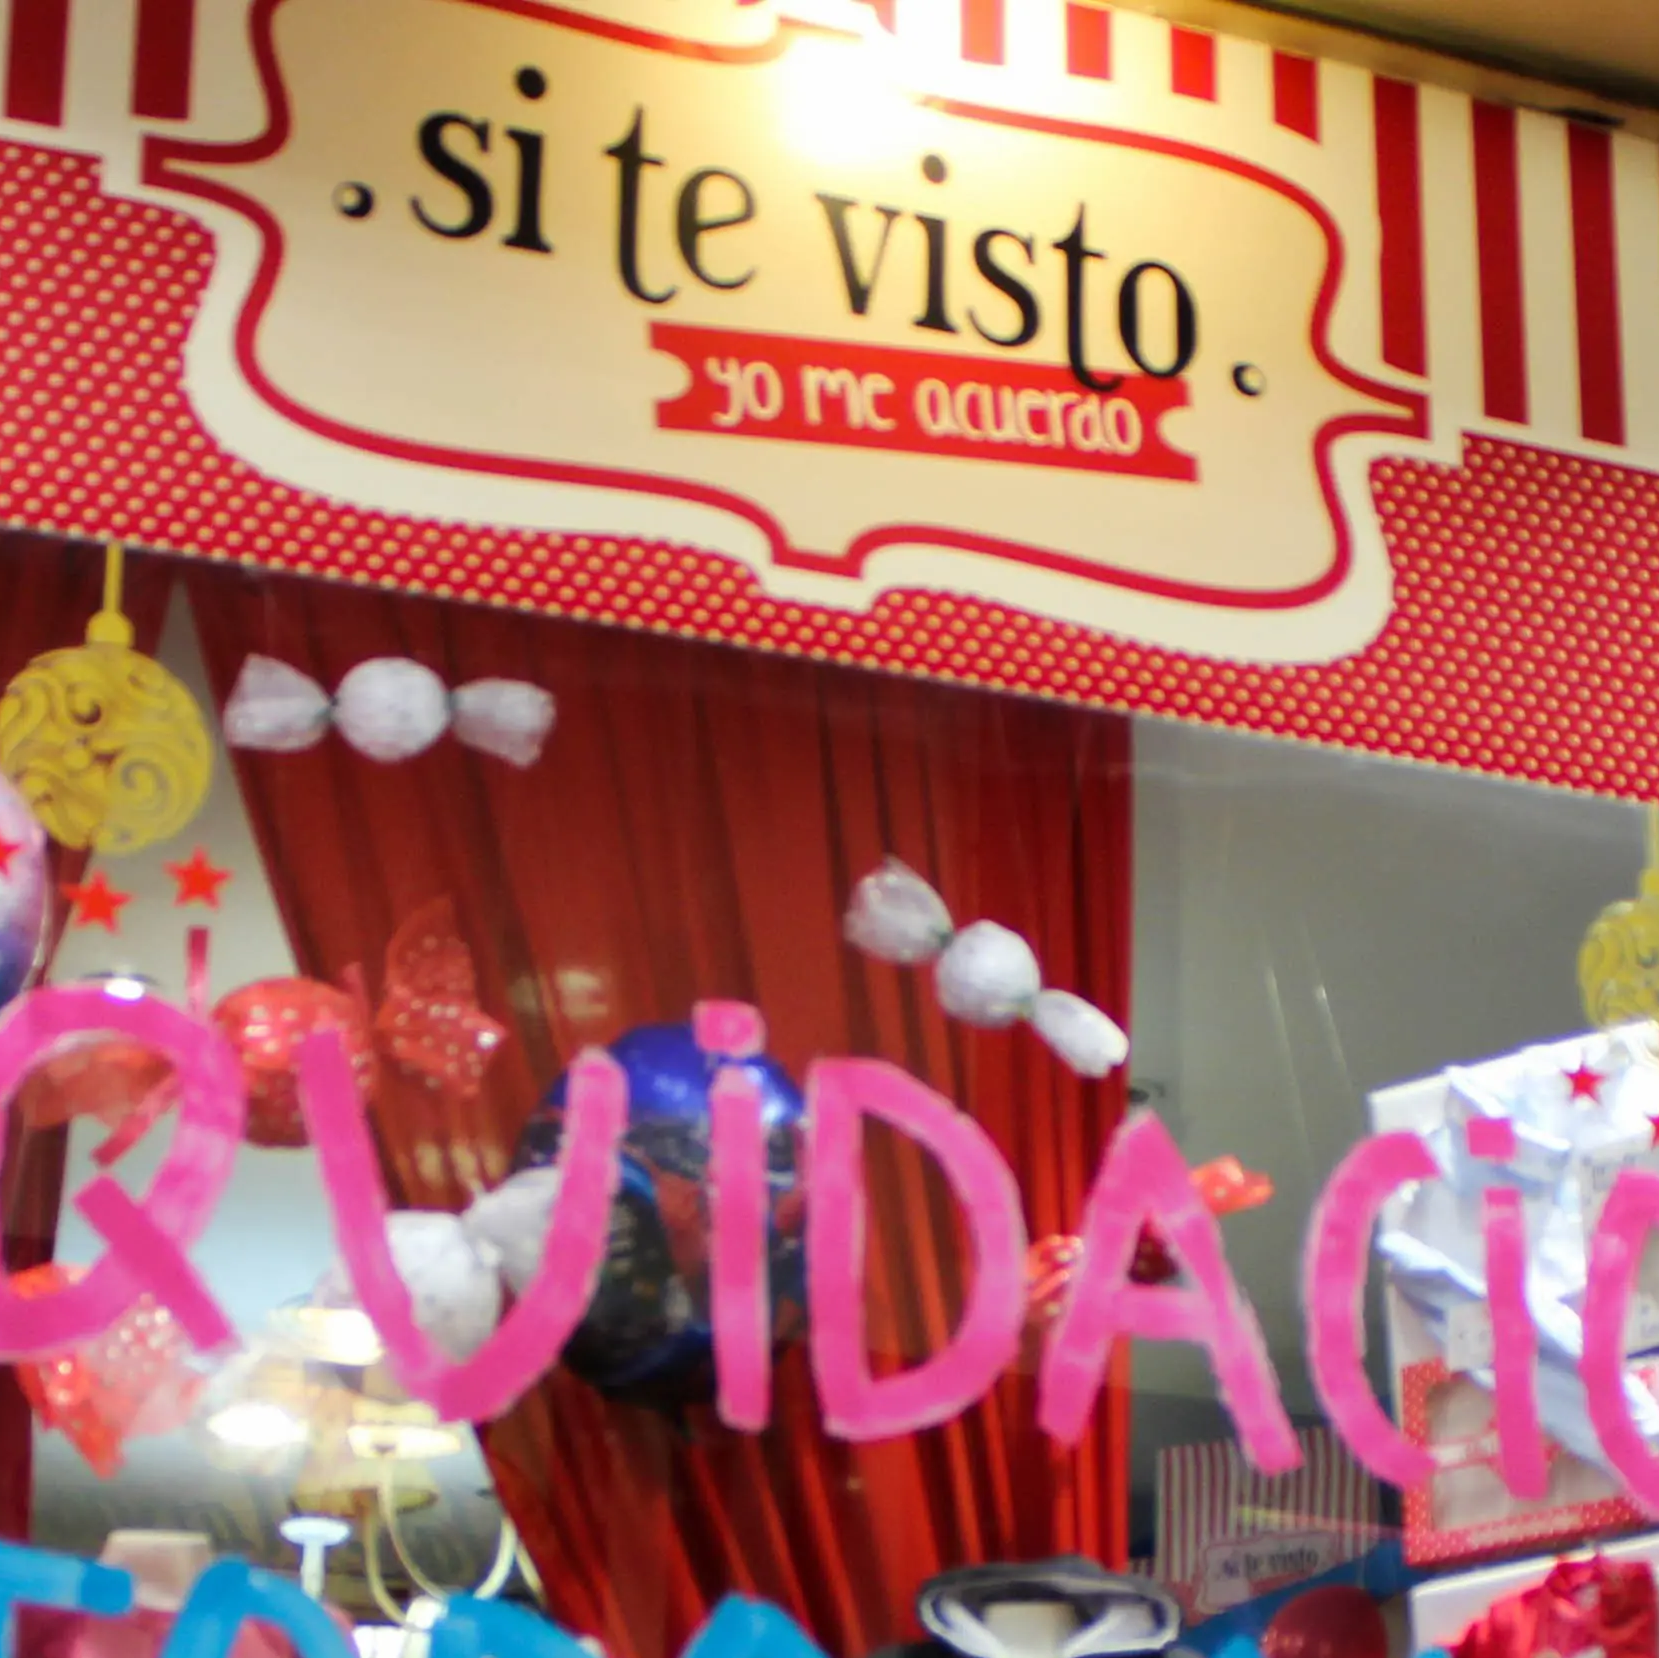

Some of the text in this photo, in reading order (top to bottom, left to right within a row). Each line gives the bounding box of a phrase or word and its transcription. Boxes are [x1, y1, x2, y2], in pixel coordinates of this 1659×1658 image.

[408, 64, 1200, 395] si te visto
[701, 356, 1146, 459] yo me acuerdo
